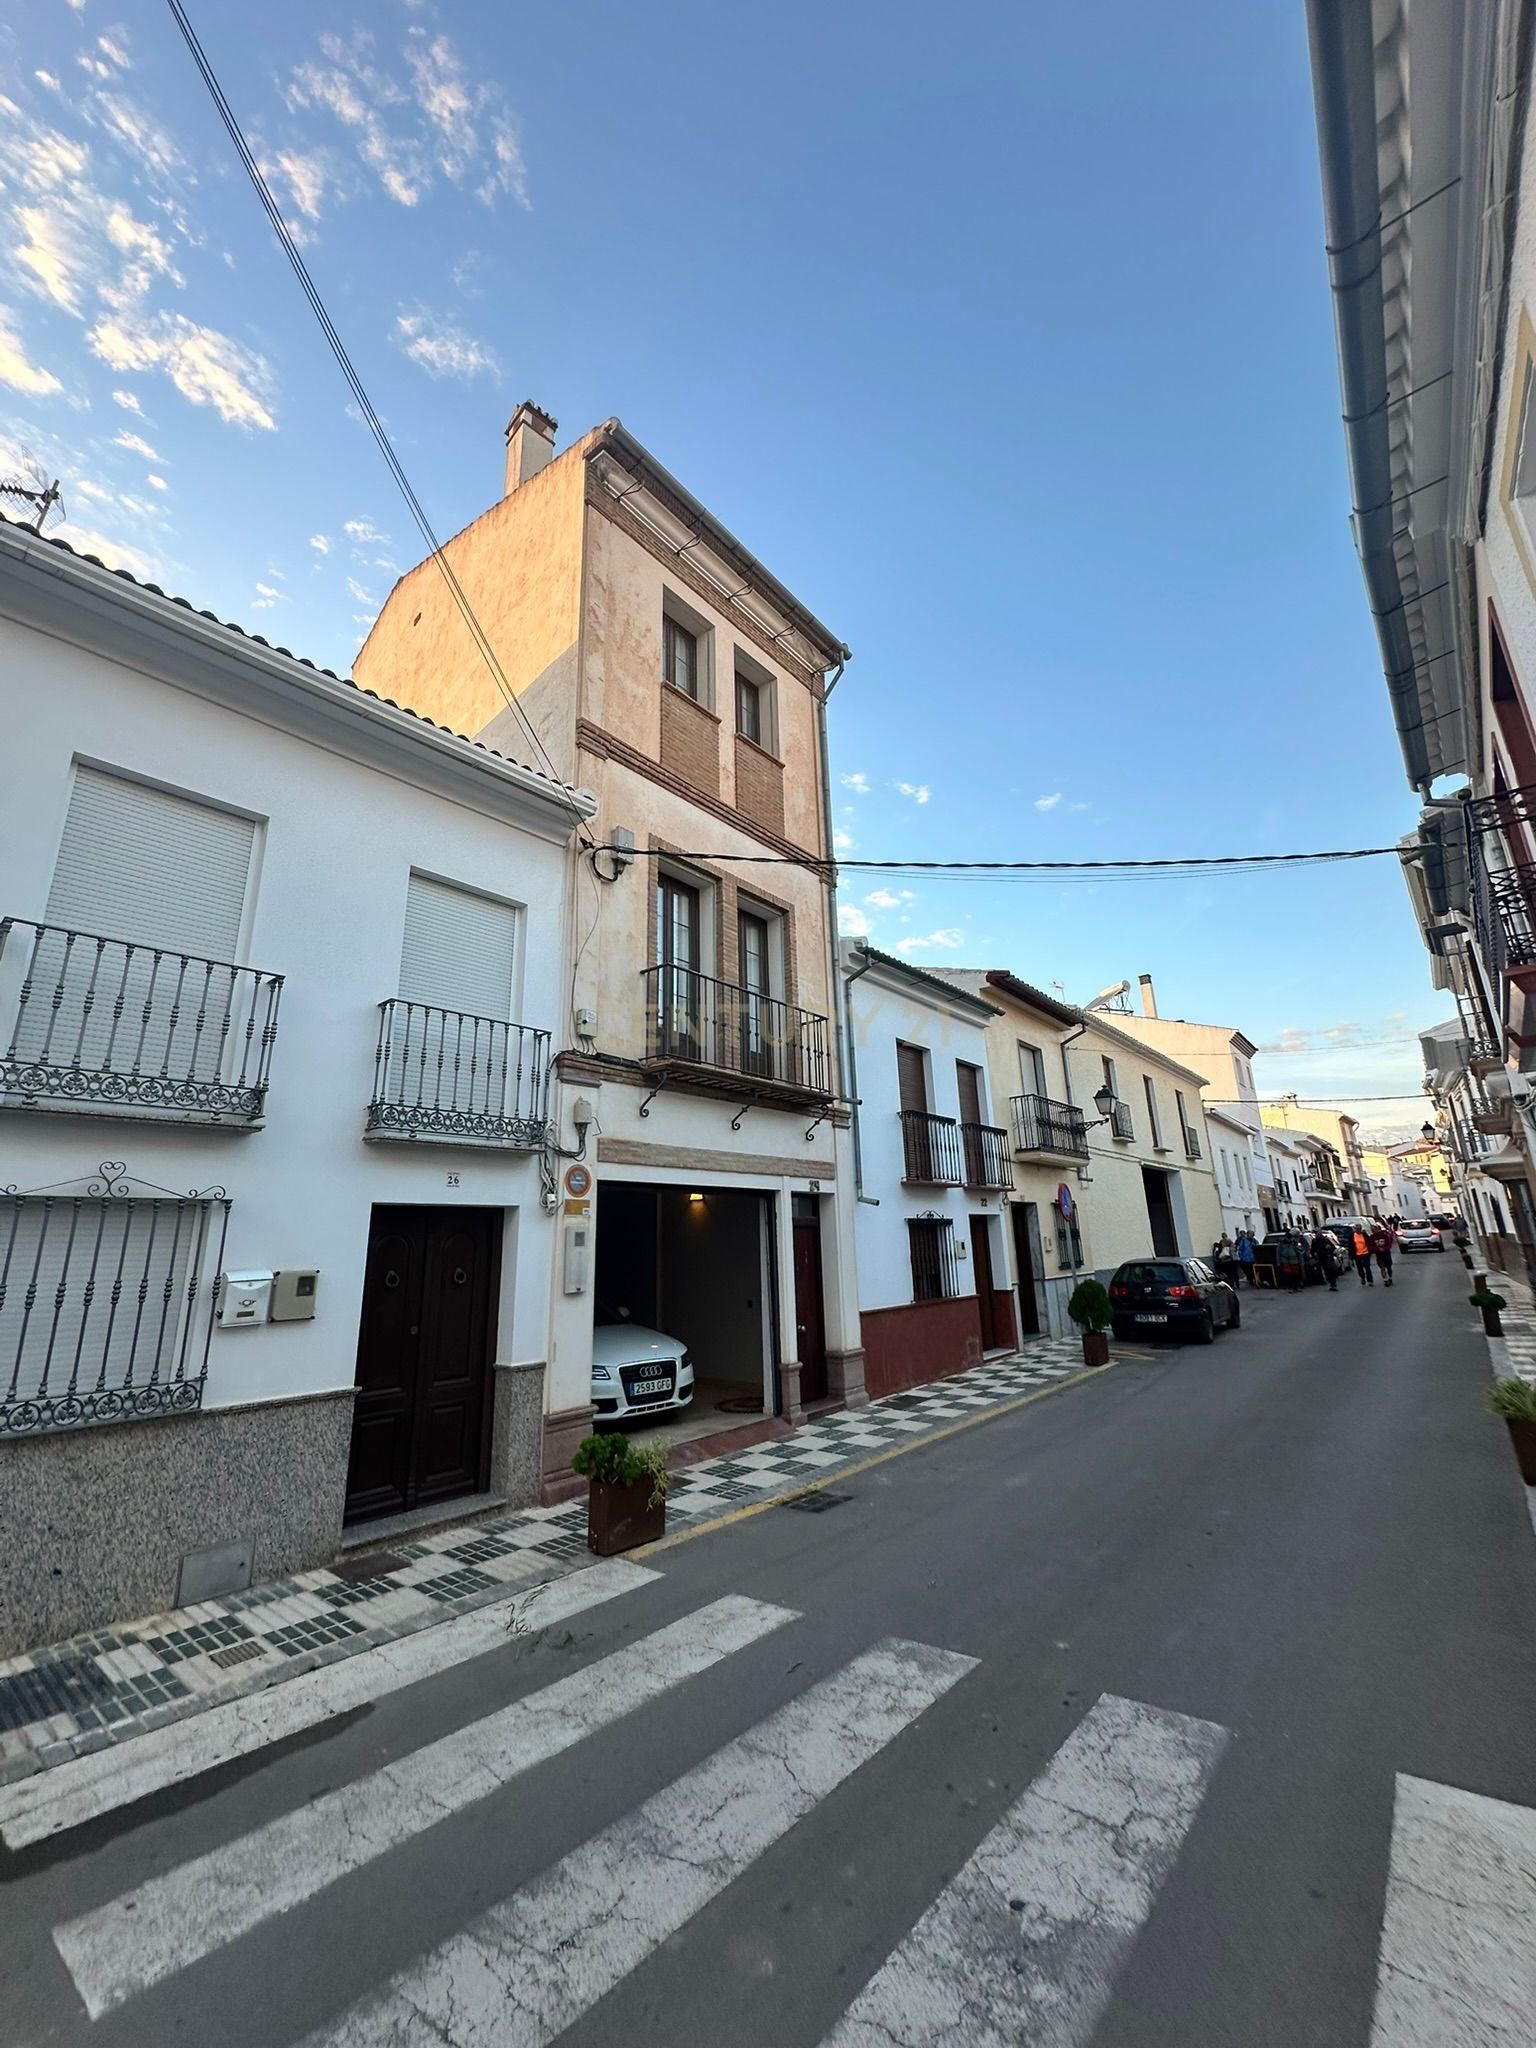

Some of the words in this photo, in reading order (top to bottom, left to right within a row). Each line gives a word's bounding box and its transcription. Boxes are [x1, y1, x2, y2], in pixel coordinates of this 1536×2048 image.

[447, 1175, 460, 1185] 26
[809, 1179, 820, 1192] 24
[980, 1197, 988, 1207] 22
[635, 1381, 655, 1394] 2593
